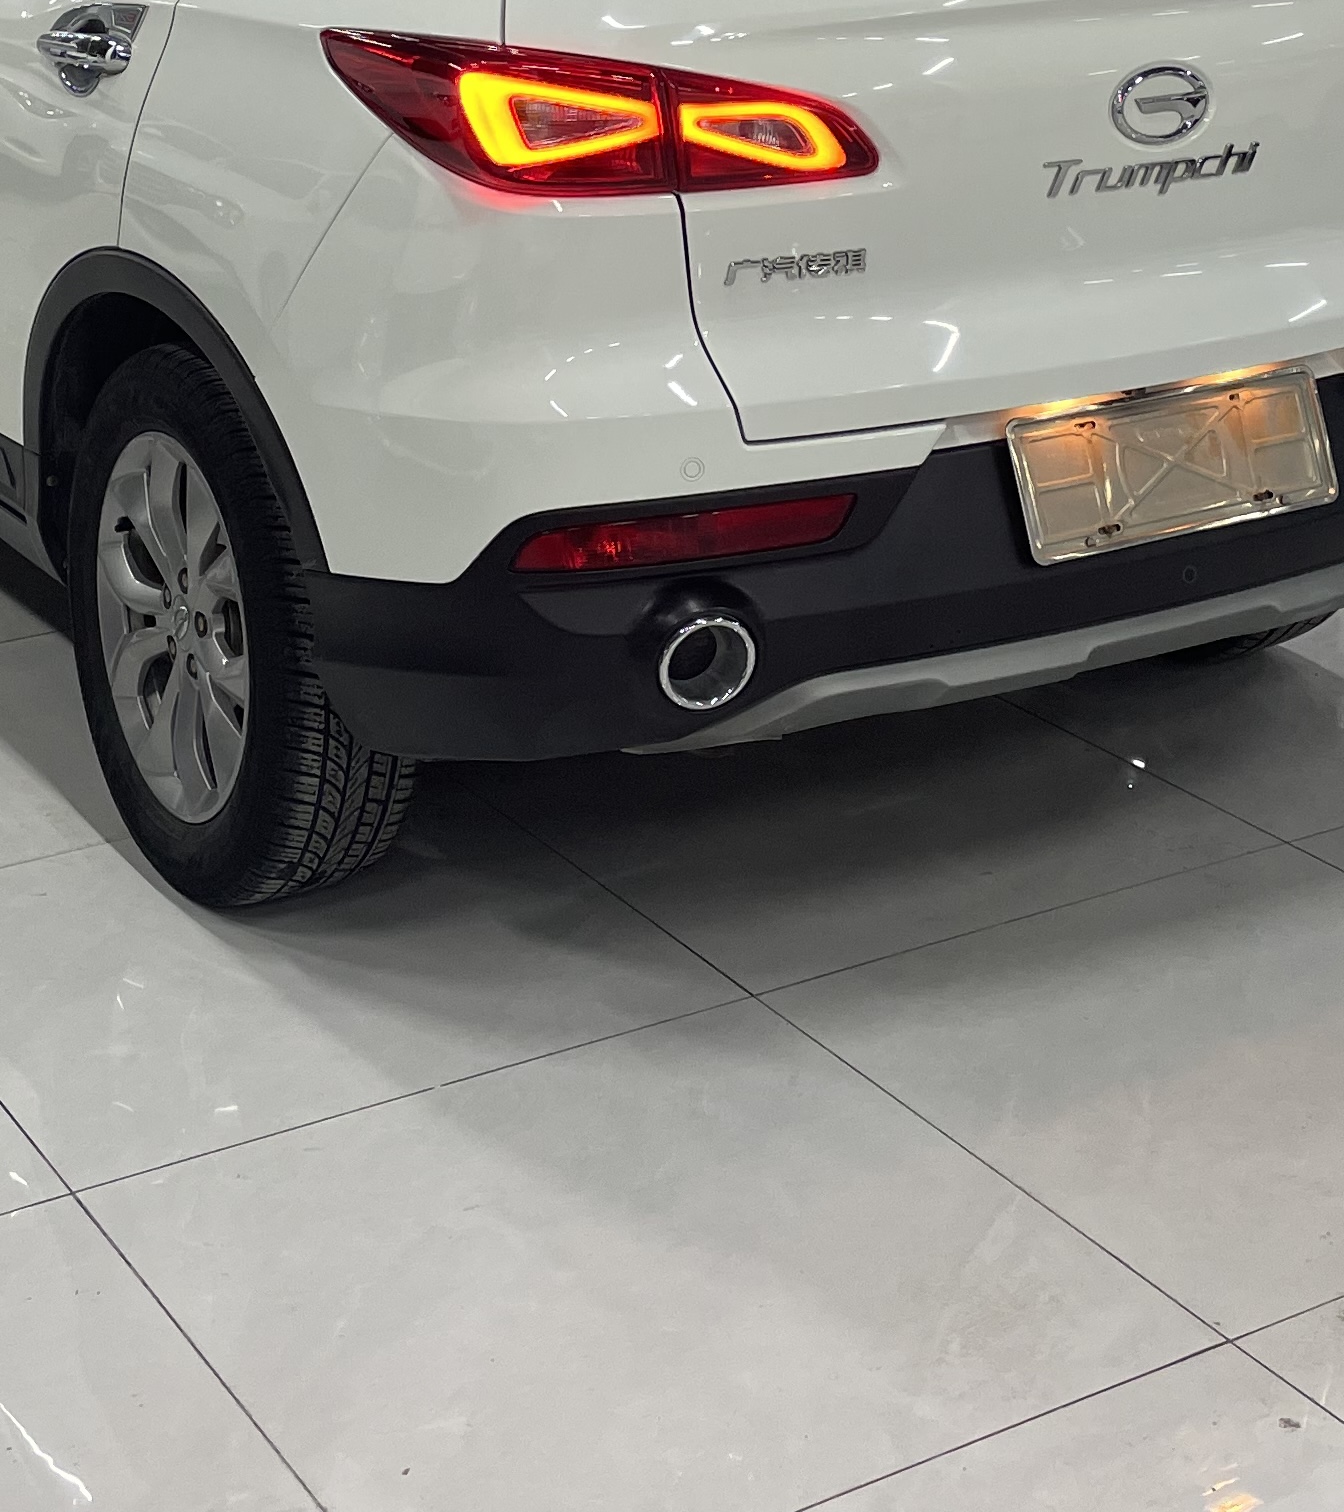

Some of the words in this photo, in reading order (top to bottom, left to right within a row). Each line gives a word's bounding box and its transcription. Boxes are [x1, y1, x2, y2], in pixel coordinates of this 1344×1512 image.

[1042, 141, 1261, 198] Trumpchi
[723, 248, 867, 286] 广汽传祺
